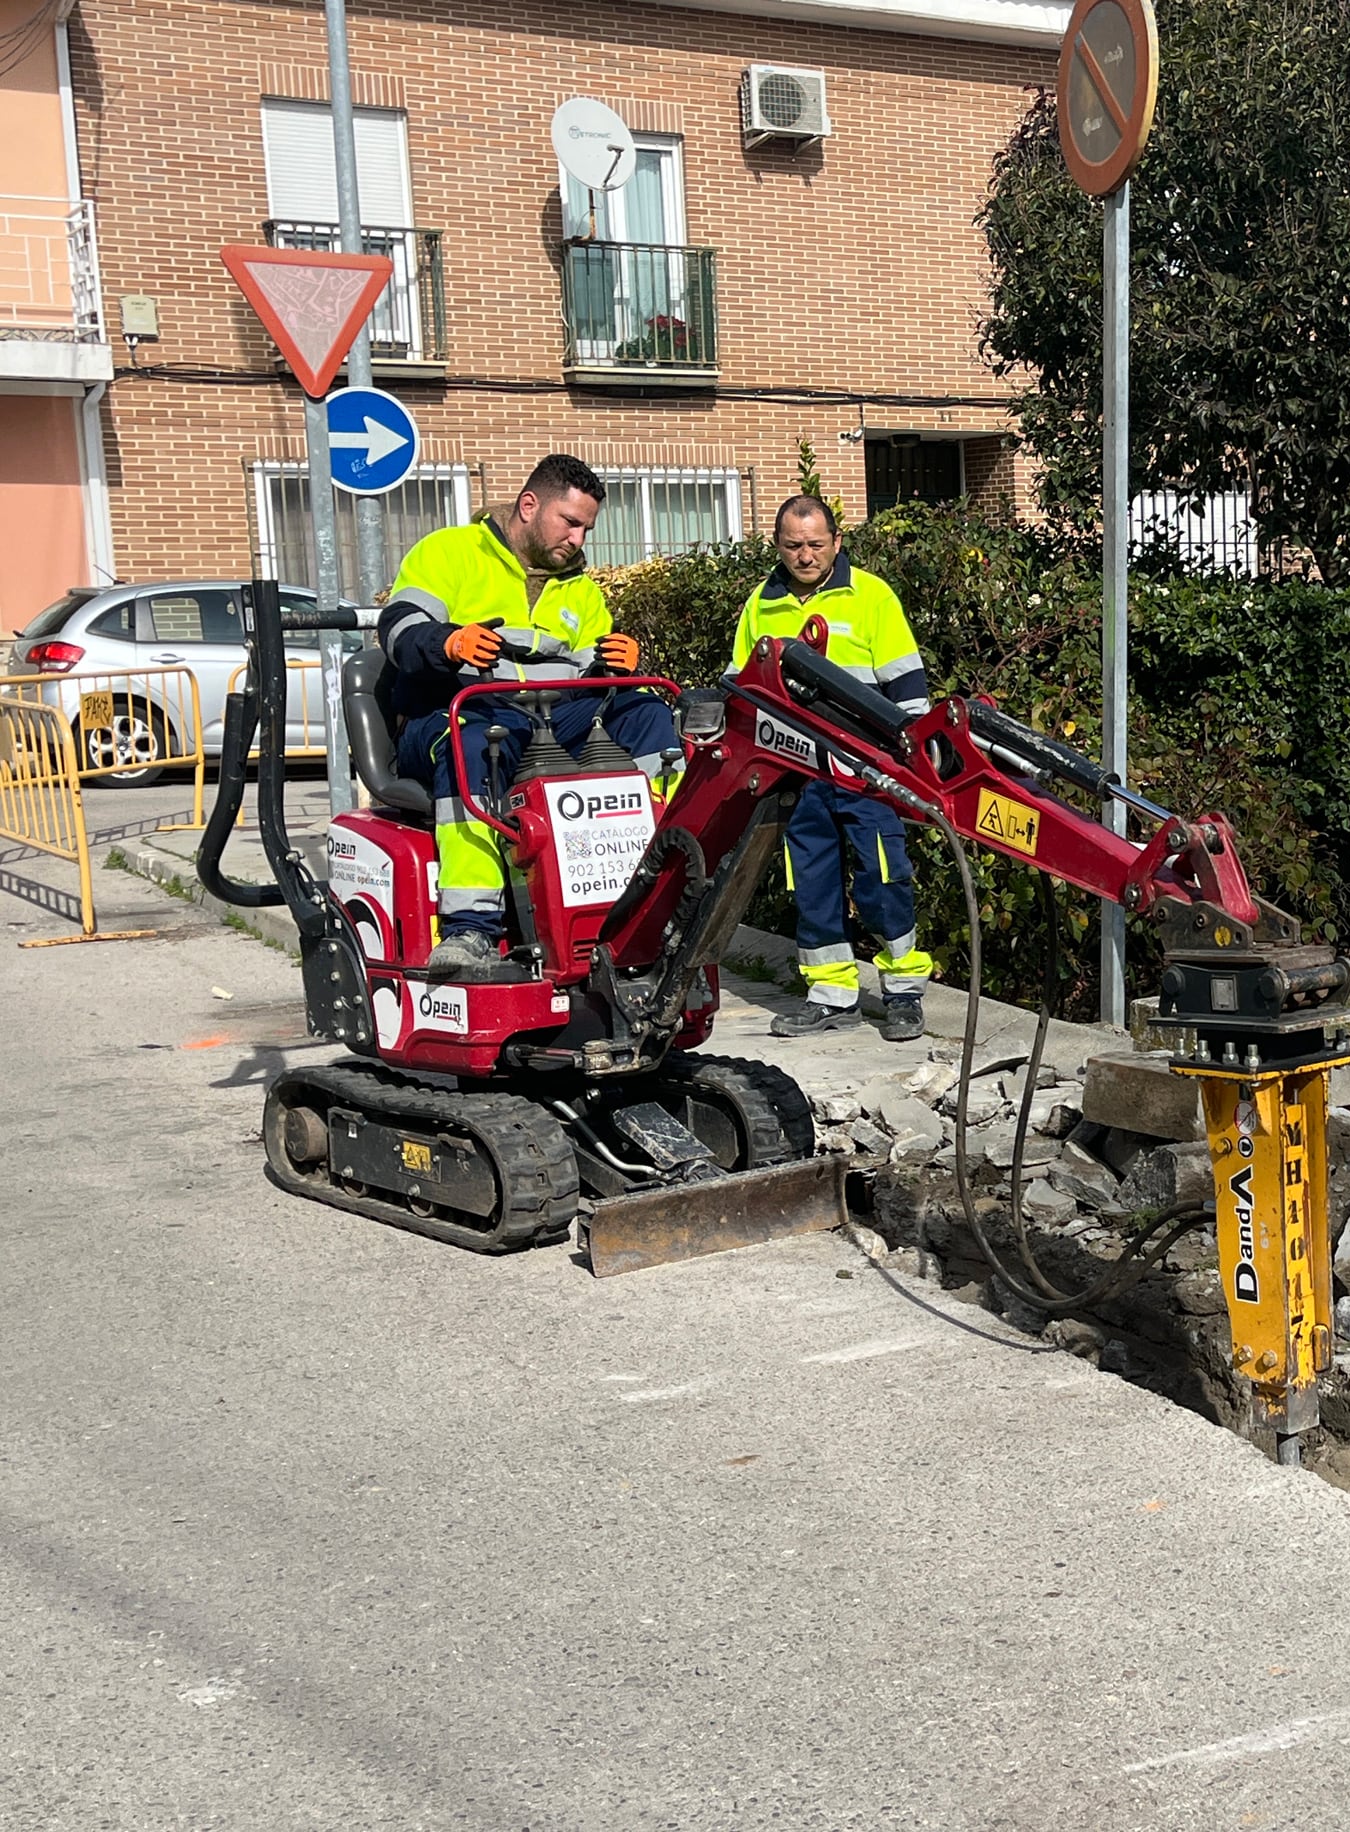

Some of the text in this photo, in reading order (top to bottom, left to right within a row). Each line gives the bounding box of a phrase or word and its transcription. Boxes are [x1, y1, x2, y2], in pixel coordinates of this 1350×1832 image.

[759, 719, 810, 756] Opein
[557, 790, 642, 821] Opein
[327, 836, 356, 857] Opein
[568, 863, 594, 878] 902
[599, 860, 624, 874] 153
[571, 876, 631, 895] opein.c
[420, 993, 461, 1018] Opein
[1230, 1165, 1258, 1303] DandA
